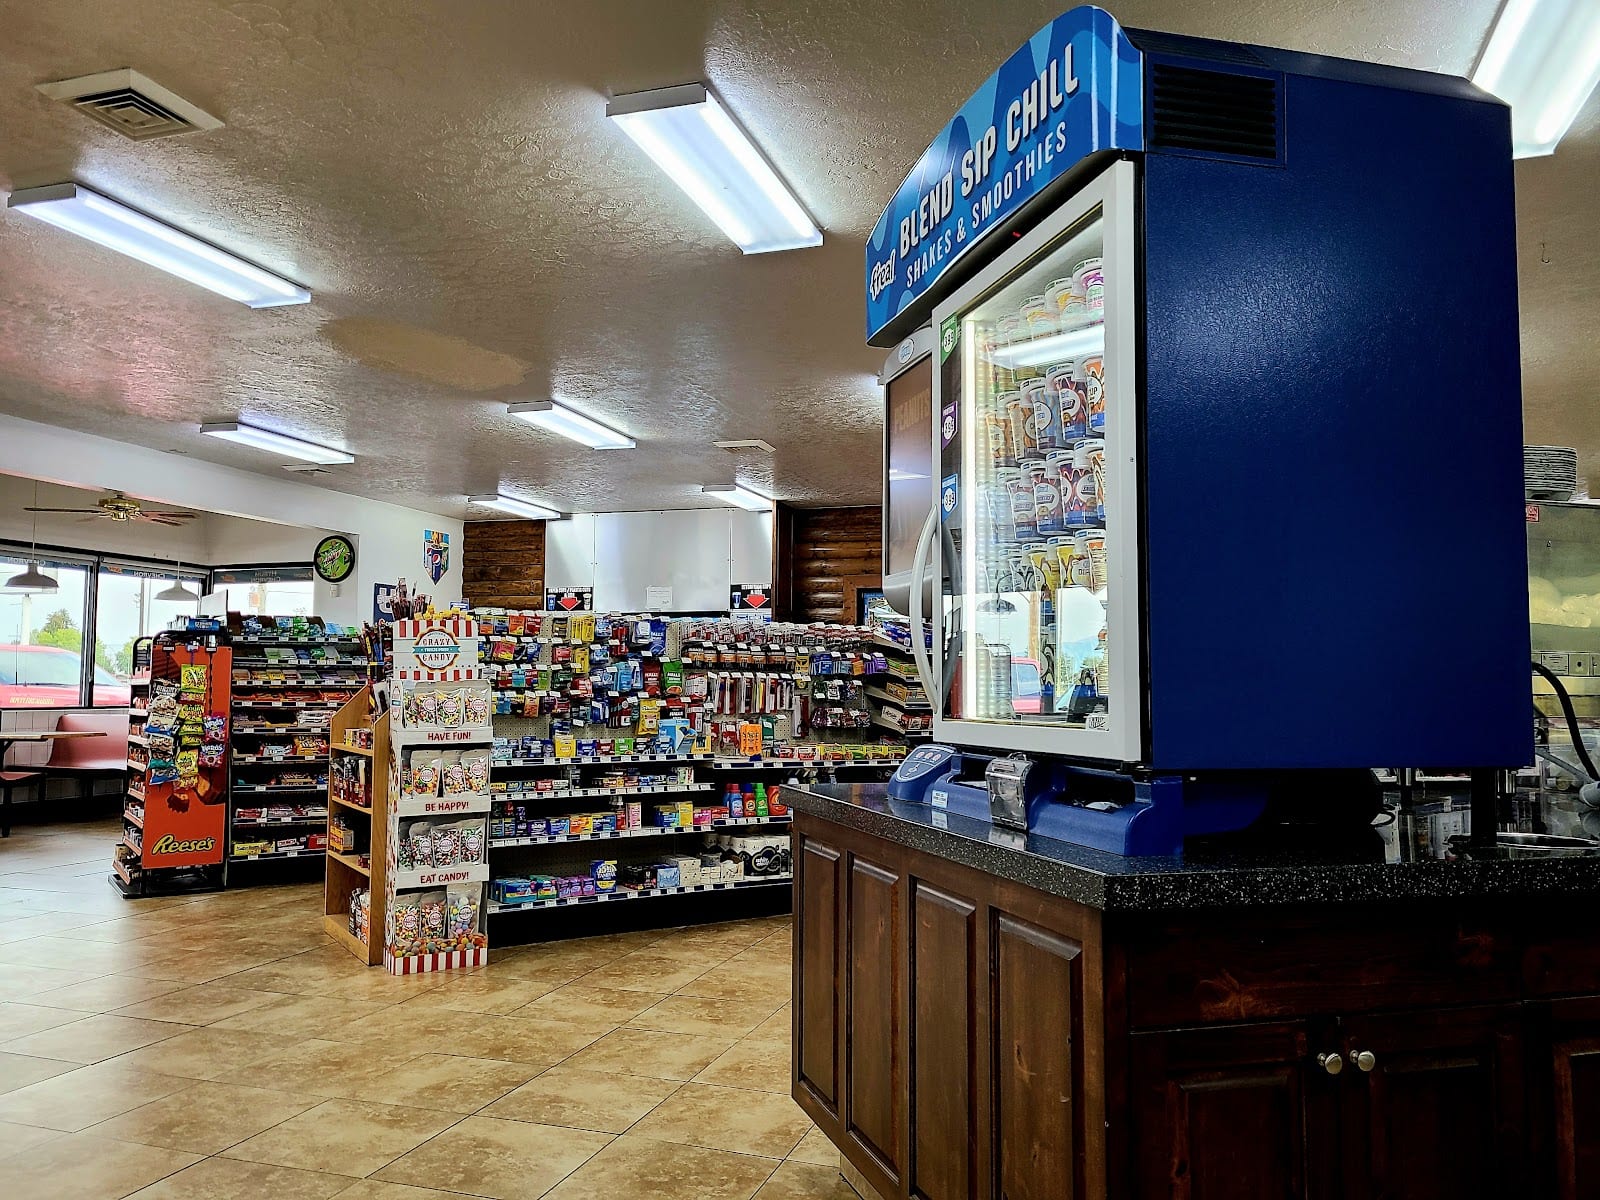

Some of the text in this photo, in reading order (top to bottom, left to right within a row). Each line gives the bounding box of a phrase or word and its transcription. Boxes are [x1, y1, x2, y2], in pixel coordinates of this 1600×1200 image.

[899, 42, 1080, 256] BLEND SIP CHILL
[906, 121, 1067, 289] SHAKES & SMOOTHIES
[422, 638, 450, 646] CRAZY
[427, 731, 471, 741] HAVE FUN!
[425, 801, 469, 812] BE HAPPY!
[151, 833, 216, 856] Reese's
[420, 871, 469, 883] EAT CANDY!
